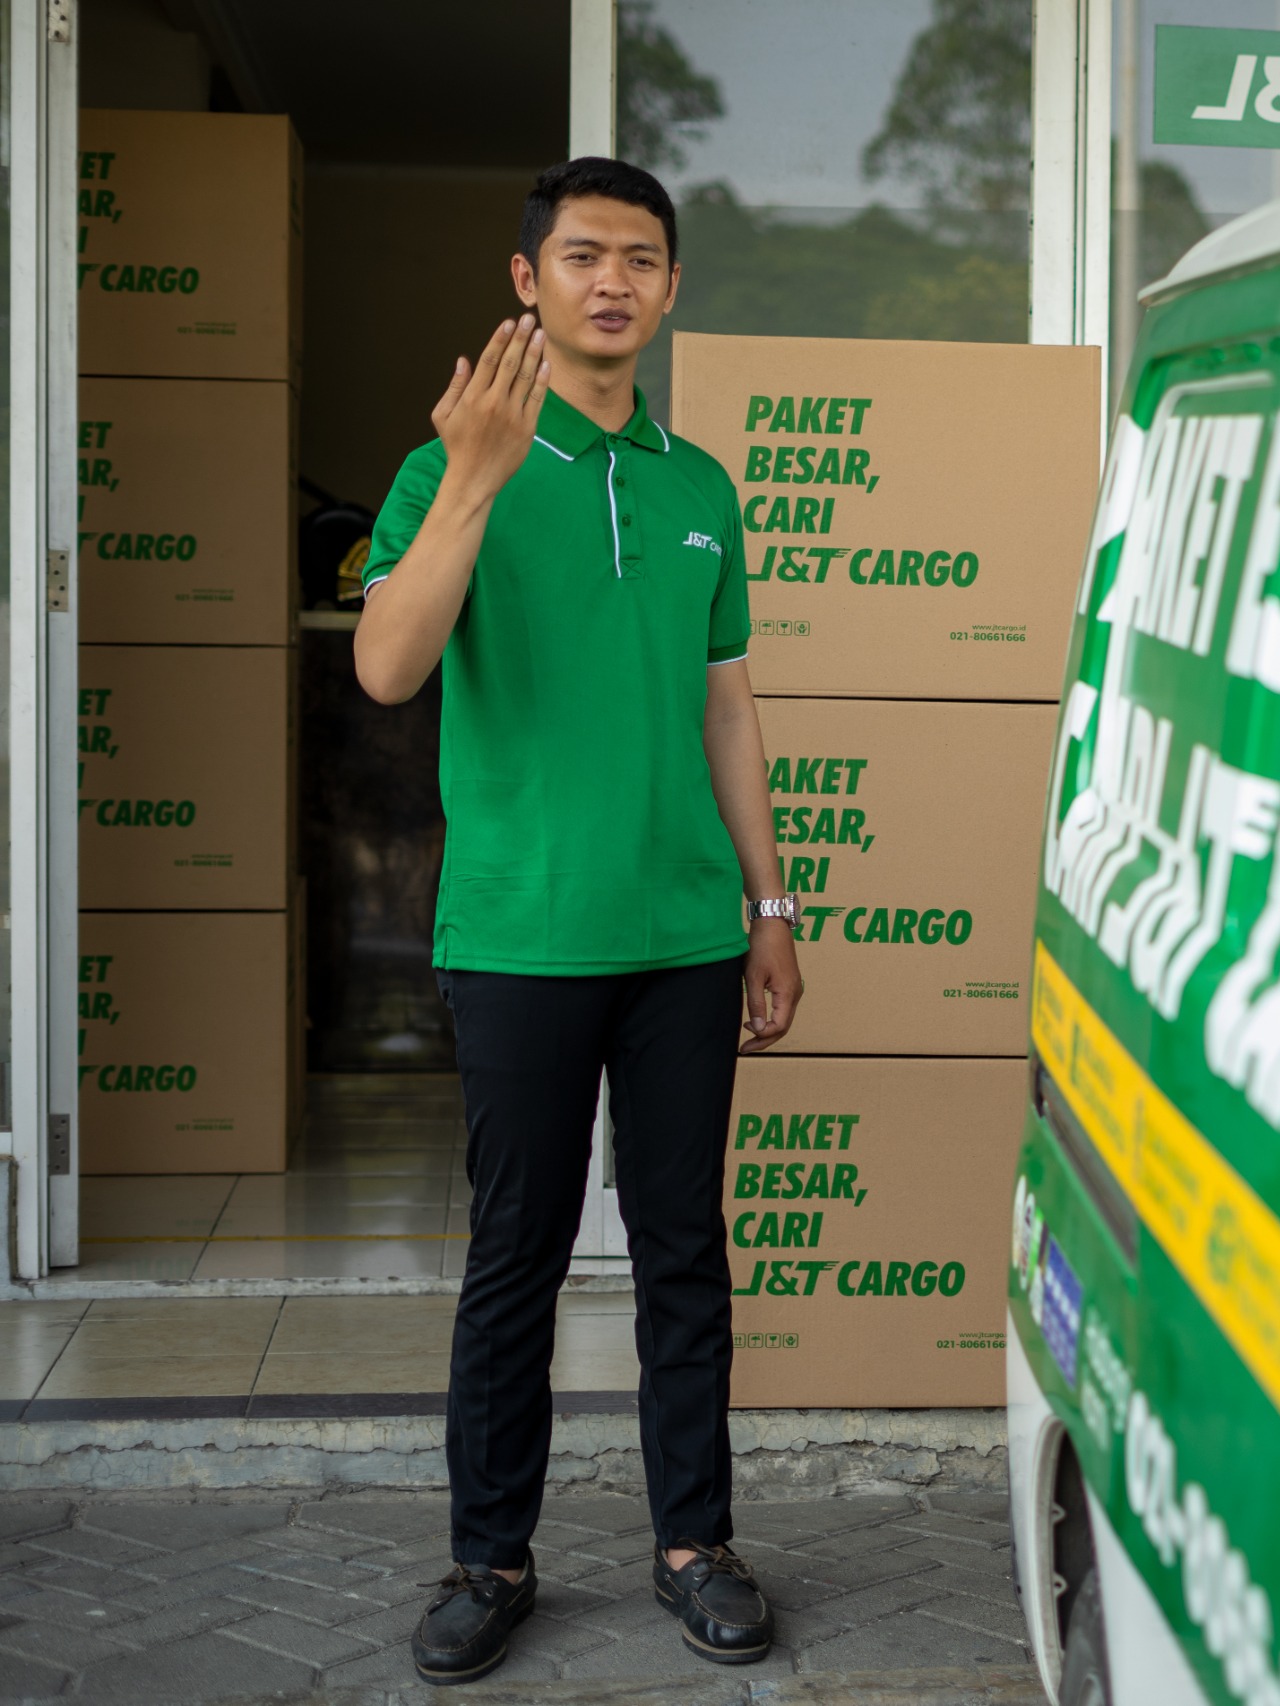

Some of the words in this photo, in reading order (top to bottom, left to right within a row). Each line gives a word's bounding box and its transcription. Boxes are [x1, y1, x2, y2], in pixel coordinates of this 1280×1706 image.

[99, 264, 200, 294] CARGO
[744, 395, 872, 435] PAKET
[743, 445, 880, 494] BESAR,
[743, 495, 836, 534] CARI
[97, 532, 197, 561] CARGO
[682, 531, 712, 549] J&T
[745, 546, 852, 583] J&T
[848, 548, 979, 588] CARGO
[950, 632, 1026, 642] 021-80661666
[972, 624, 1027, 632] www.jtcargo.id
[764, 757, 869, 795] AKET
[96, 799, 196, 828] CARGO
[771, 806, 876, 854] ESAR,
[843, 906, 973, 946] CARGO
[943, 989, 1019, 999] 021-80661666
[965, 981, 1020, 989] www.jtcargo.id
[97, 1064, 197, 1093] CARGO
[734, 1113, 861, 1151] PAKET
[734, 1162, 869, 1208] BESAR,
[732, 1211, 824, 1249] CARI
[731, 1260, 841, 1297] J&T
[836, 1260, 967, 1298] CARGO
[936, 1340, 1007, 1349] 021-8066166
[959, 1332, 1006, 1340] www.jtcargo.
